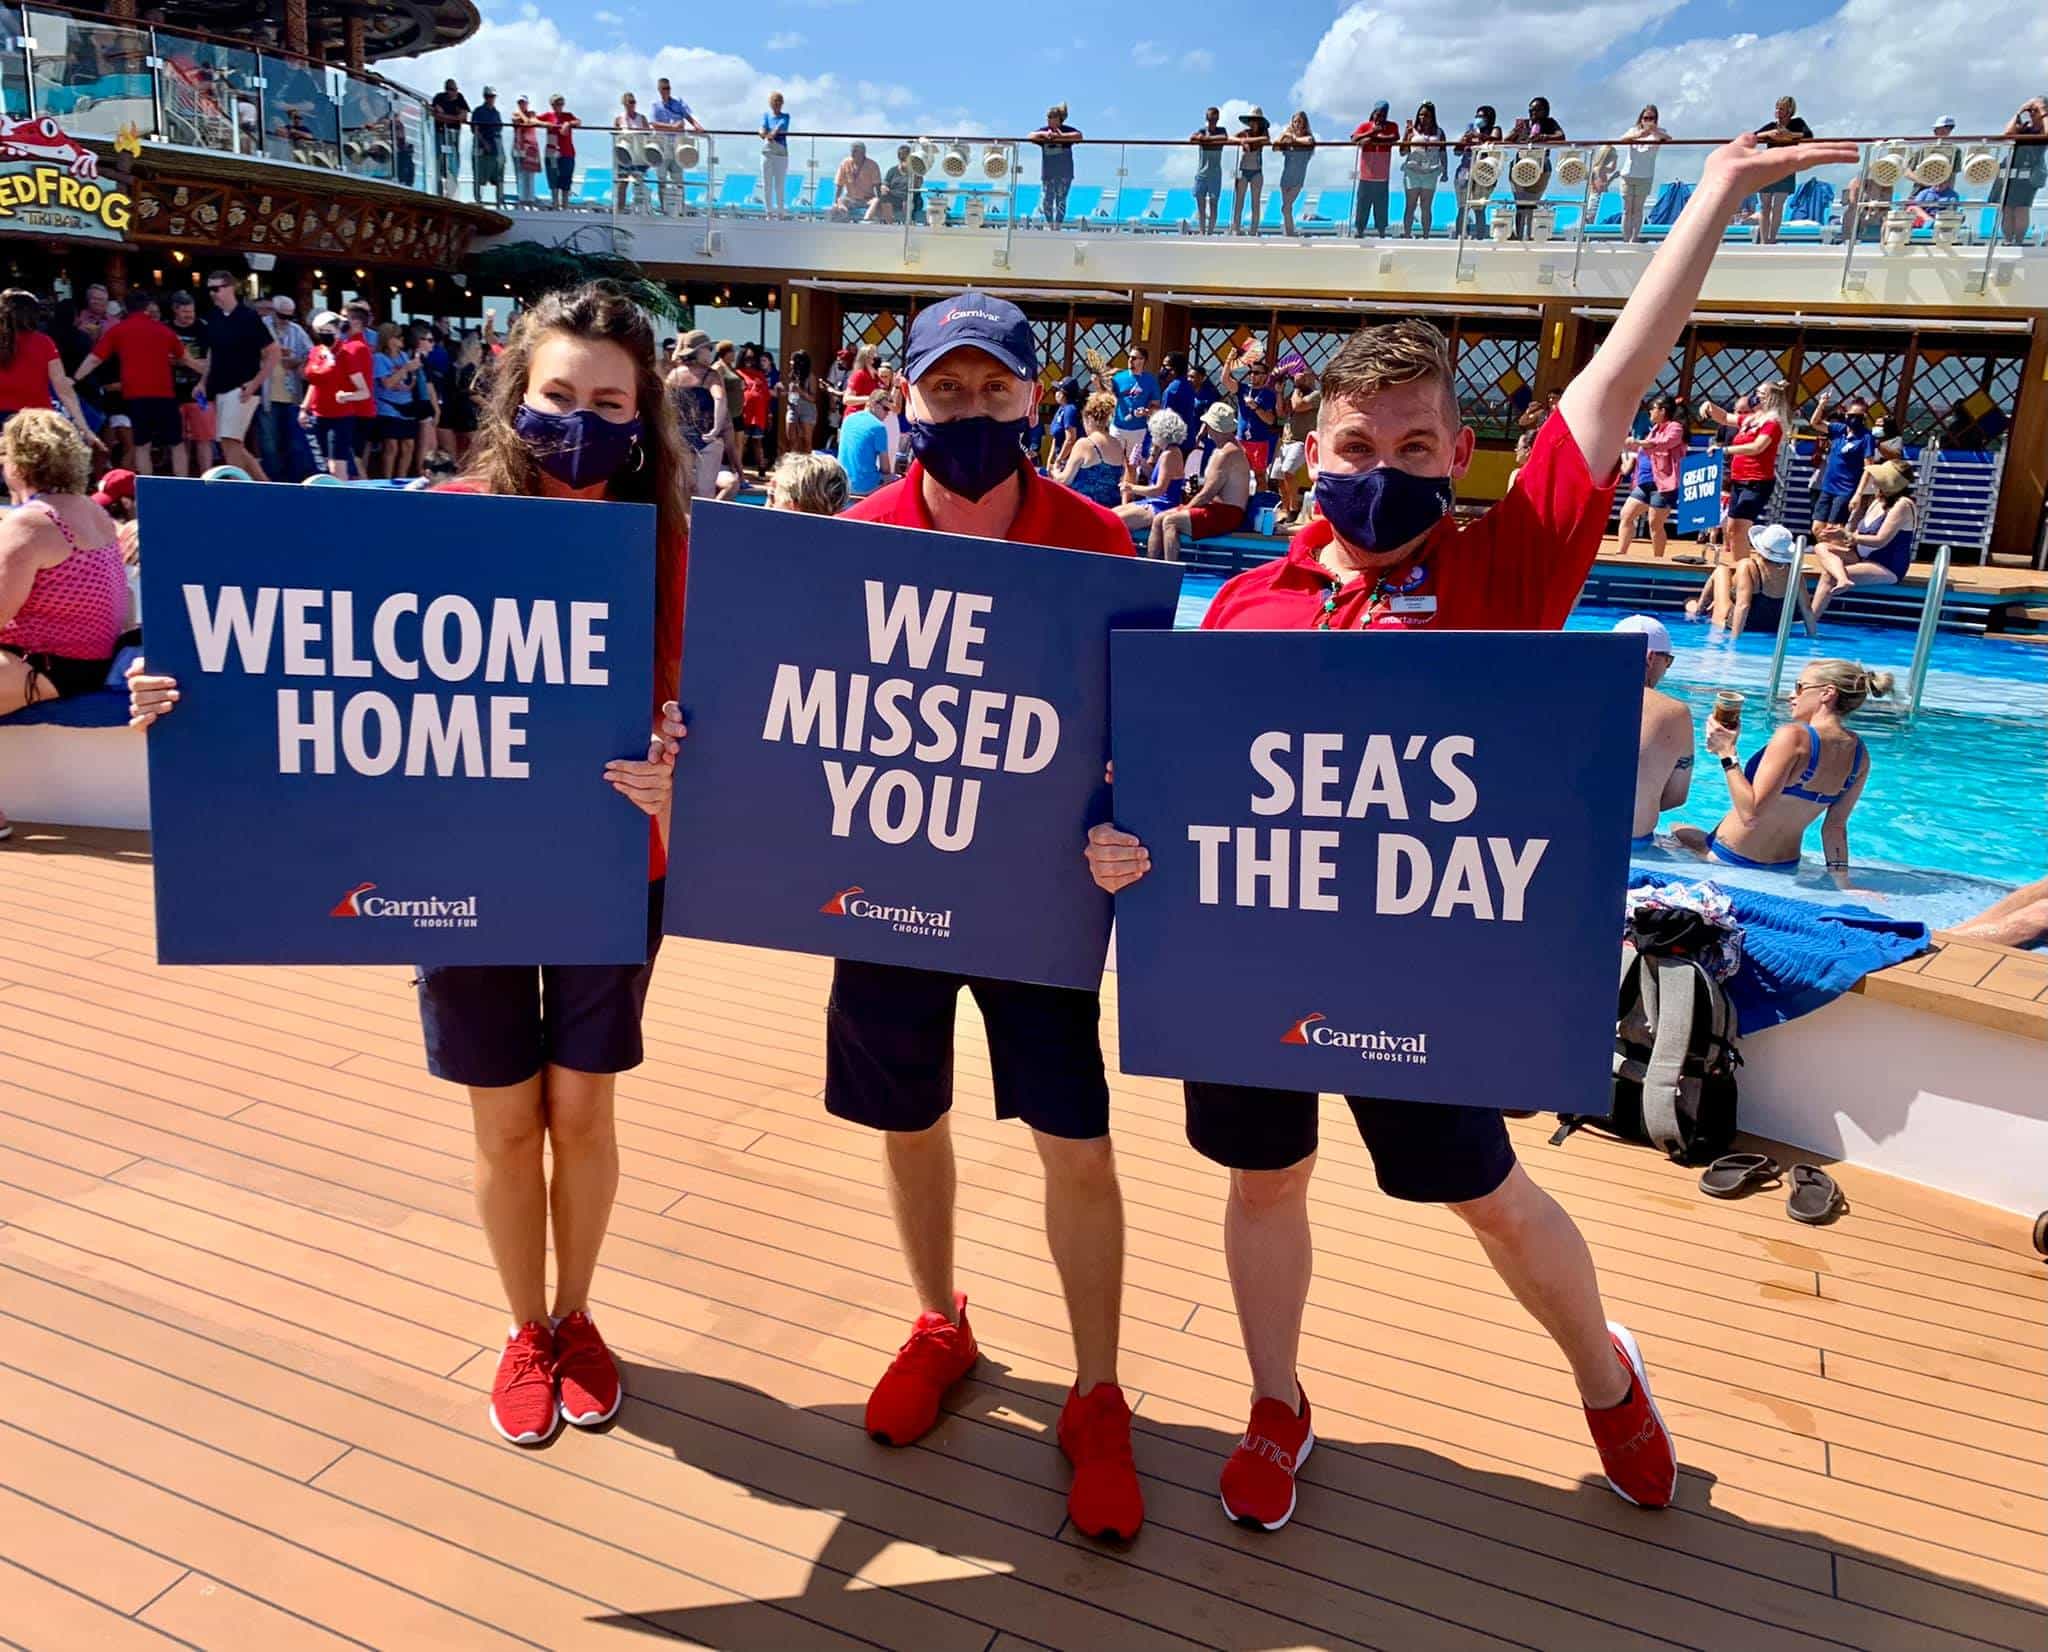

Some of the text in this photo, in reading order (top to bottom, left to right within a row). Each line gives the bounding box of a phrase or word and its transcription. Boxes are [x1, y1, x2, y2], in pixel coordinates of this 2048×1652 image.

[1683, 464, 1718, 487] GREAT TO
[1684, 481, 1715, 502] SEA YOU
[183, 585, 608, 685] WELCOME
[865, 580, 992, 676] WE
[763, 664, 1059, 774] MISSED
[278, 690, 529, 778] HOME
[1251, 732, 1476, 822] SEA'S
[823, 761, 981, 851] YOU
[1189, 826, 1549, 921] THE DAY
[363, 896, 477, 917] Carnival
[850, 899, 953, 928] Carnival
[413, 918, 477, 928] CHOOSE FUN
[893, 922, 951, 938] CHOOSE FUN
[1312, 1027, 1427, 1053] Carnival
[1361, 1050, 1427, 1065] CHOOSE FUN
